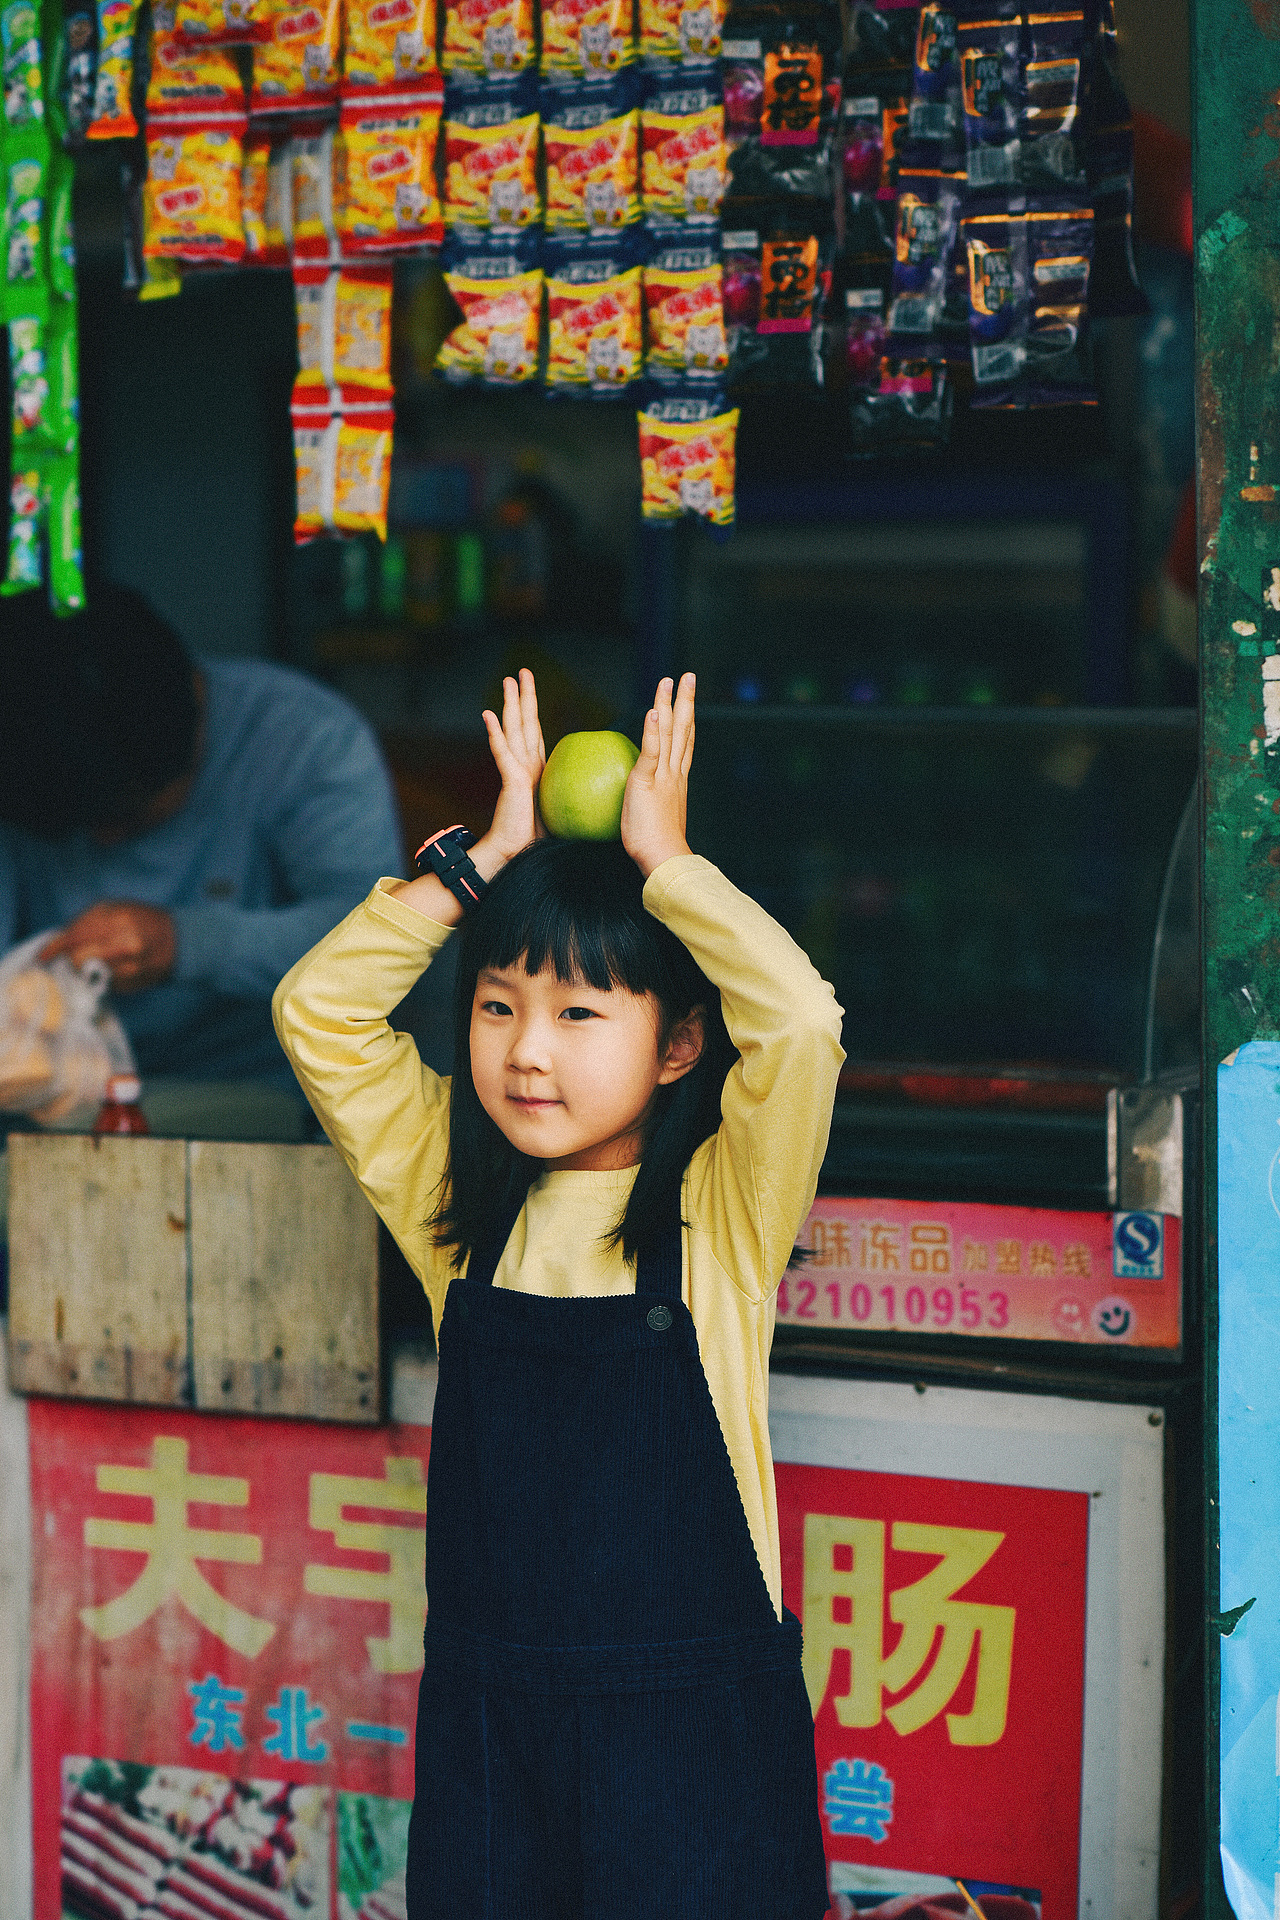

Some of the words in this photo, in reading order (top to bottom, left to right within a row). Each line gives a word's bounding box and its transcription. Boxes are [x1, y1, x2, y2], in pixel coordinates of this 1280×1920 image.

[960, 1238, 1093, 1279] 加盟热线
[802, 1513, 1016, 1747] 肠
[188, 1676, 408, 1762] 东北一
[824, 1757, 895, 1844] 尝
